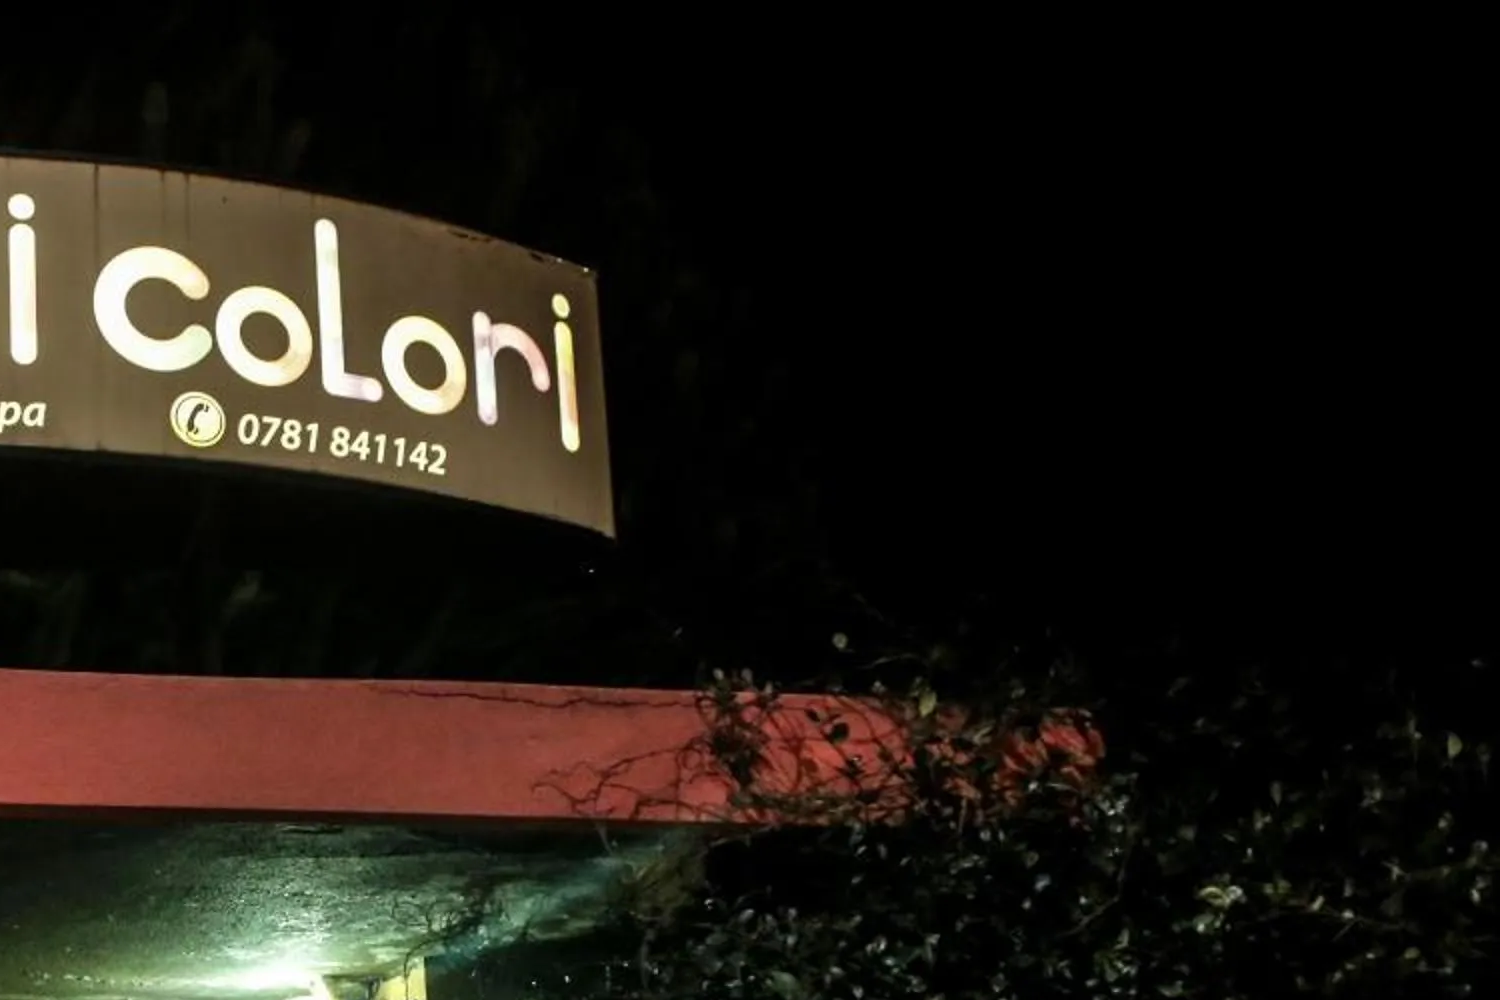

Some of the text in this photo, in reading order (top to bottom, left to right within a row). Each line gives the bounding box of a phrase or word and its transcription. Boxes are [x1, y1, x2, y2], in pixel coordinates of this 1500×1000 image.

[7, 192, 38, 366] i
[236, 412, 448, 476] 0781 841142
